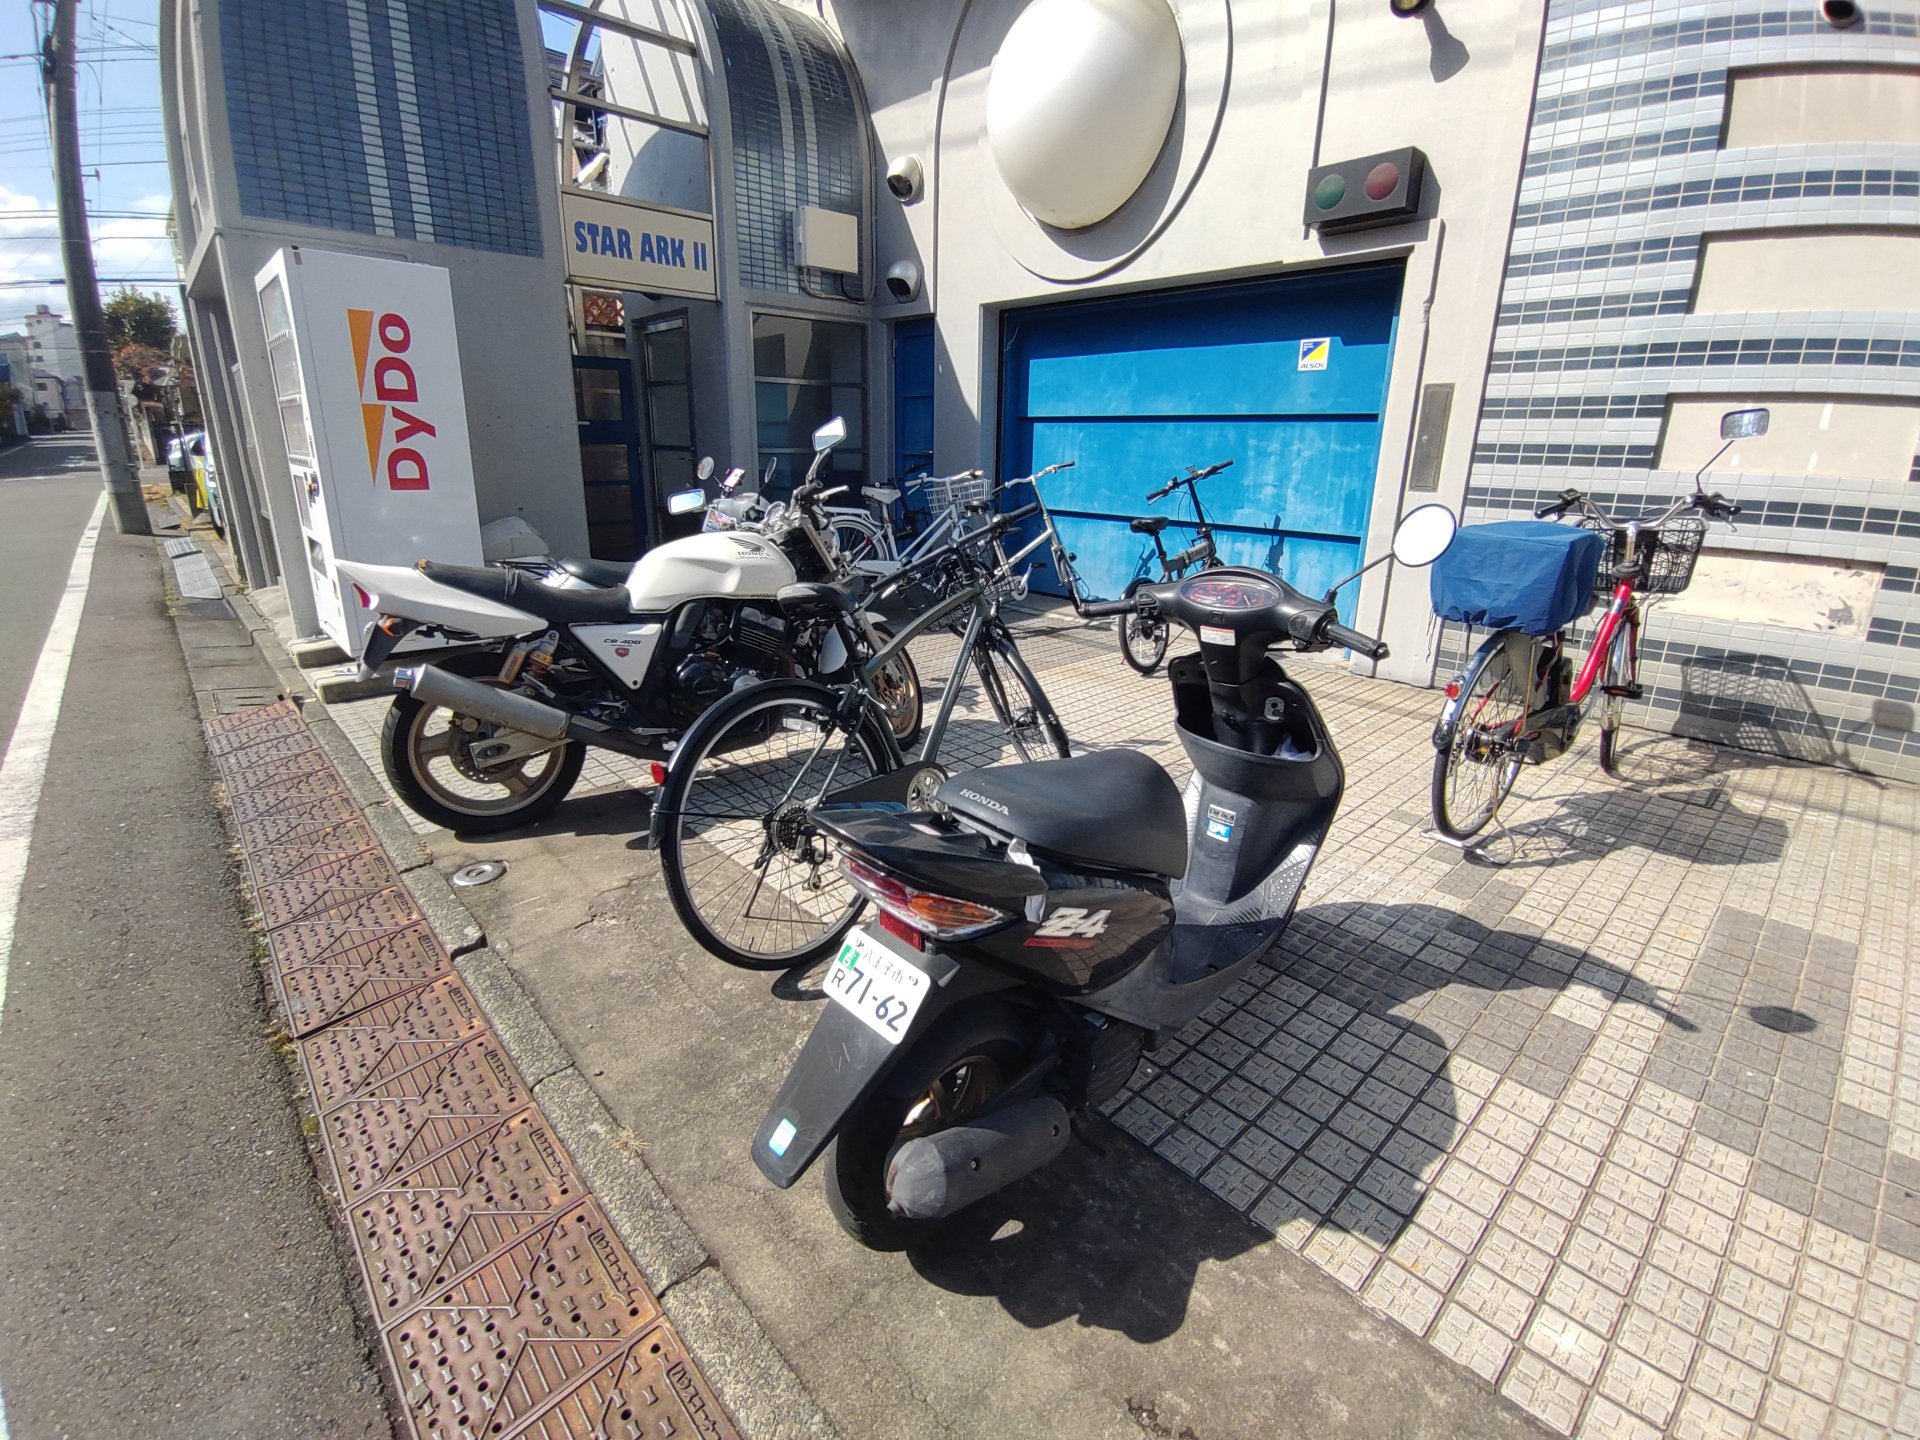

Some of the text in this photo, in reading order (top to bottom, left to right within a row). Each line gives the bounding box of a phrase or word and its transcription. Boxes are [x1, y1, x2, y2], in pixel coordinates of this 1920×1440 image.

[574, 220, 708, 271] STAR ARK II
[374, 313, 437, 491] DyDo
[959, 788, 1010, 816] HONDA
[1033, 907, 1111, 938] Z4
[863, 949, 904, 984] 八王子市
[831, 967, 908, 1032] R 71-62
